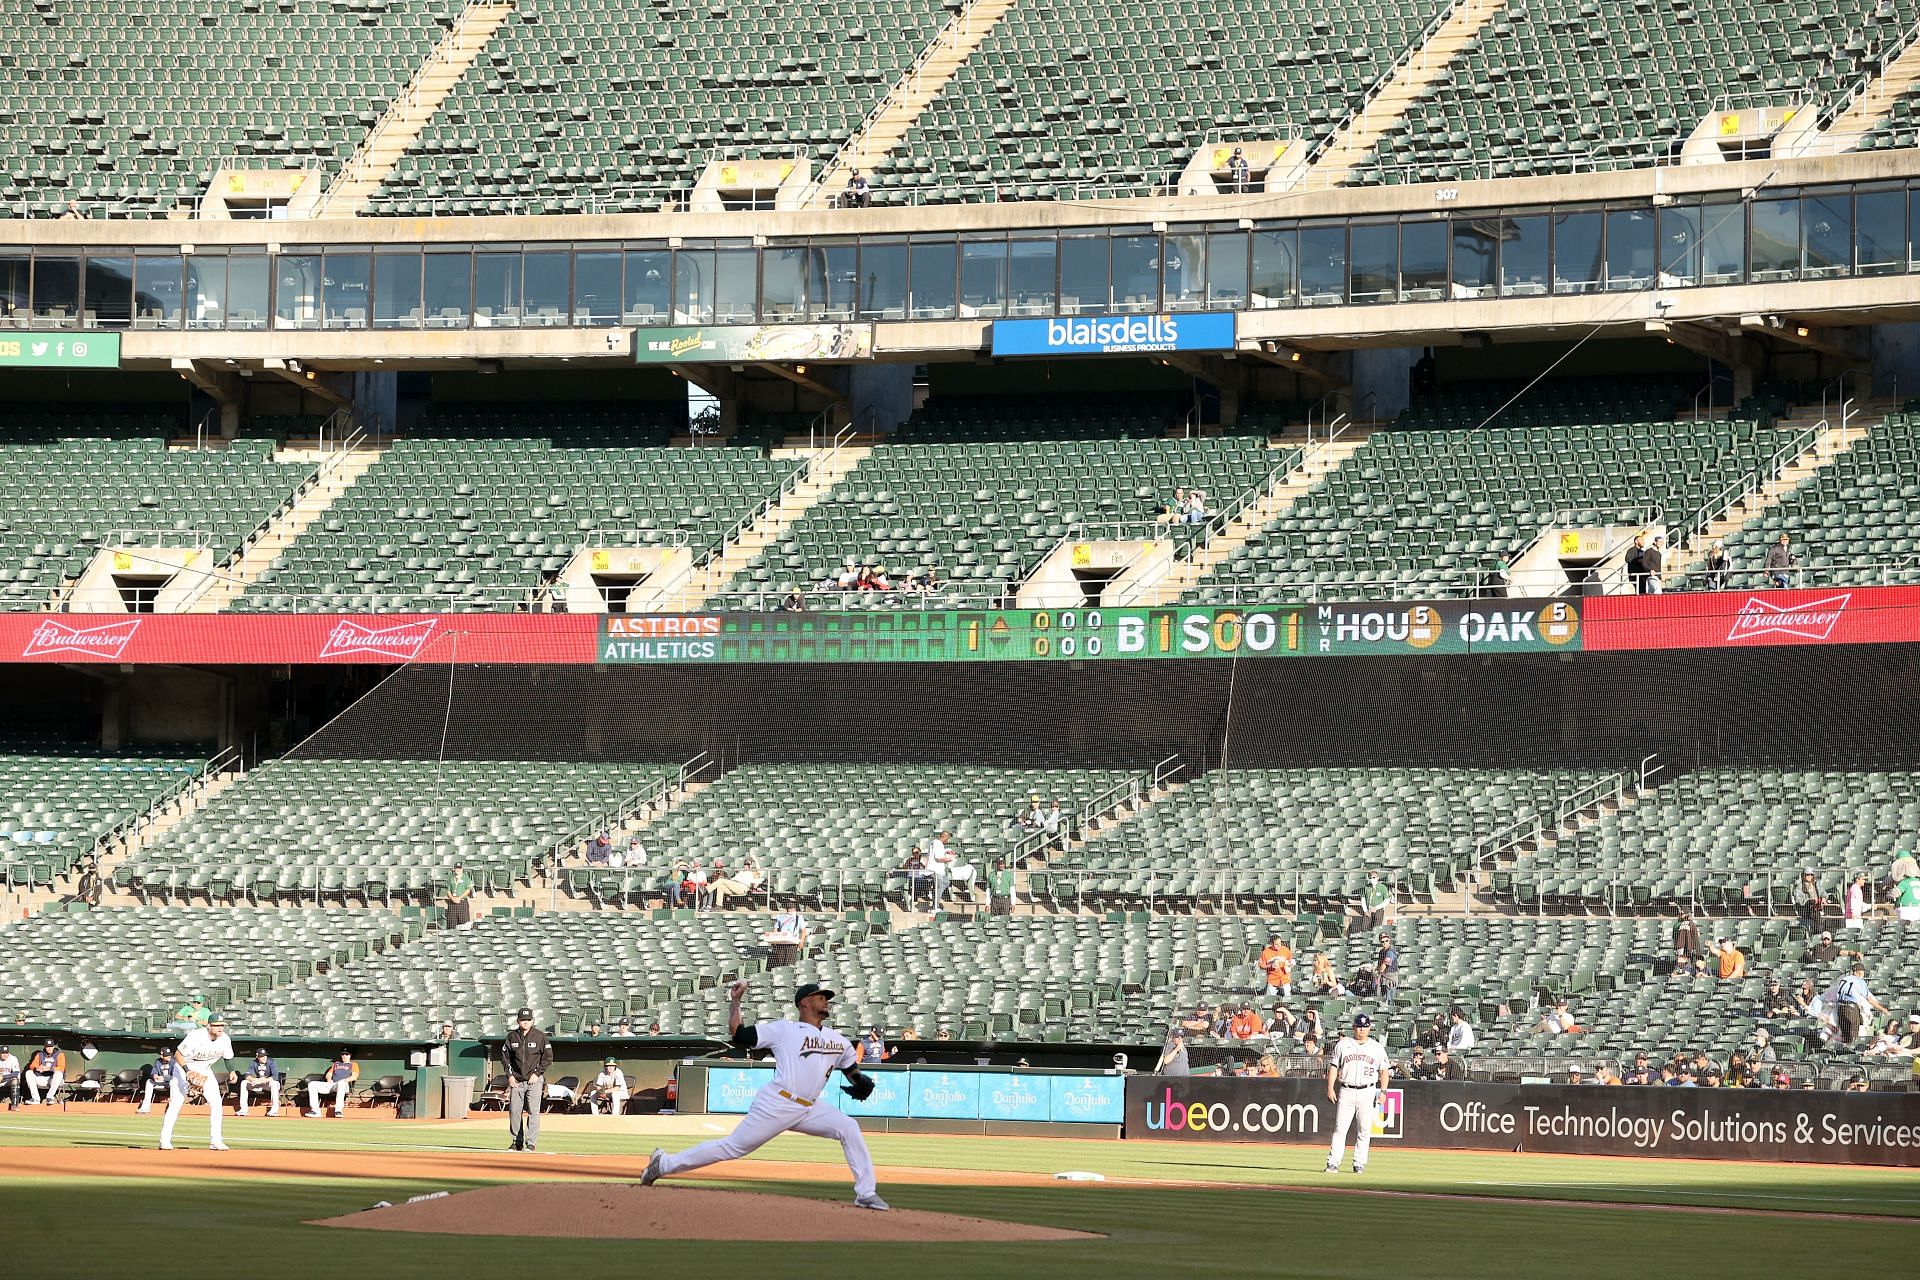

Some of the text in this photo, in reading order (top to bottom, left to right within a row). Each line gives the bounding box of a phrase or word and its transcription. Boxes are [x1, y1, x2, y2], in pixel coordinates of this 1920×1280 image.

[1766, 119, 1778, 128] EXIT
[1435, 188, 1458, 201] 307
[648, 341, 658, 351] WE
[671, 331, 702, 354] Rooted
[1103, 342, 1176, 354] BUSINESS PRODUCTS
[1586, 542, 1598, 551] EXIT
[609, 611, 1101, 637] ASTROS 0 0 0
[1336, 605, 1430, 641] HOU 5
[1459, 602, 1567, 642] OAK 5
[1737, 607, 1838, 628] Budweiser
[34, 628, 130, 647] Budweiser
[330, 629, 425, 647] Budweiser
[968, 620, 978, 651] 1
[1118, 612, 1298, 652] B 1 S 0 O 1
[604, 636, 1101, 659] ATHLETICS 0 0 0
[800, 1035, 845, 1053] Athletics
[1343, 1053, 1376, 1065] HOUSTON
[1363, 1066, 1375, 1077] 22
[1146, 1087, 1319, 1133] ubeo.com
[1439, 1101, 1920, 1148] Office Technology Solutions & Services
